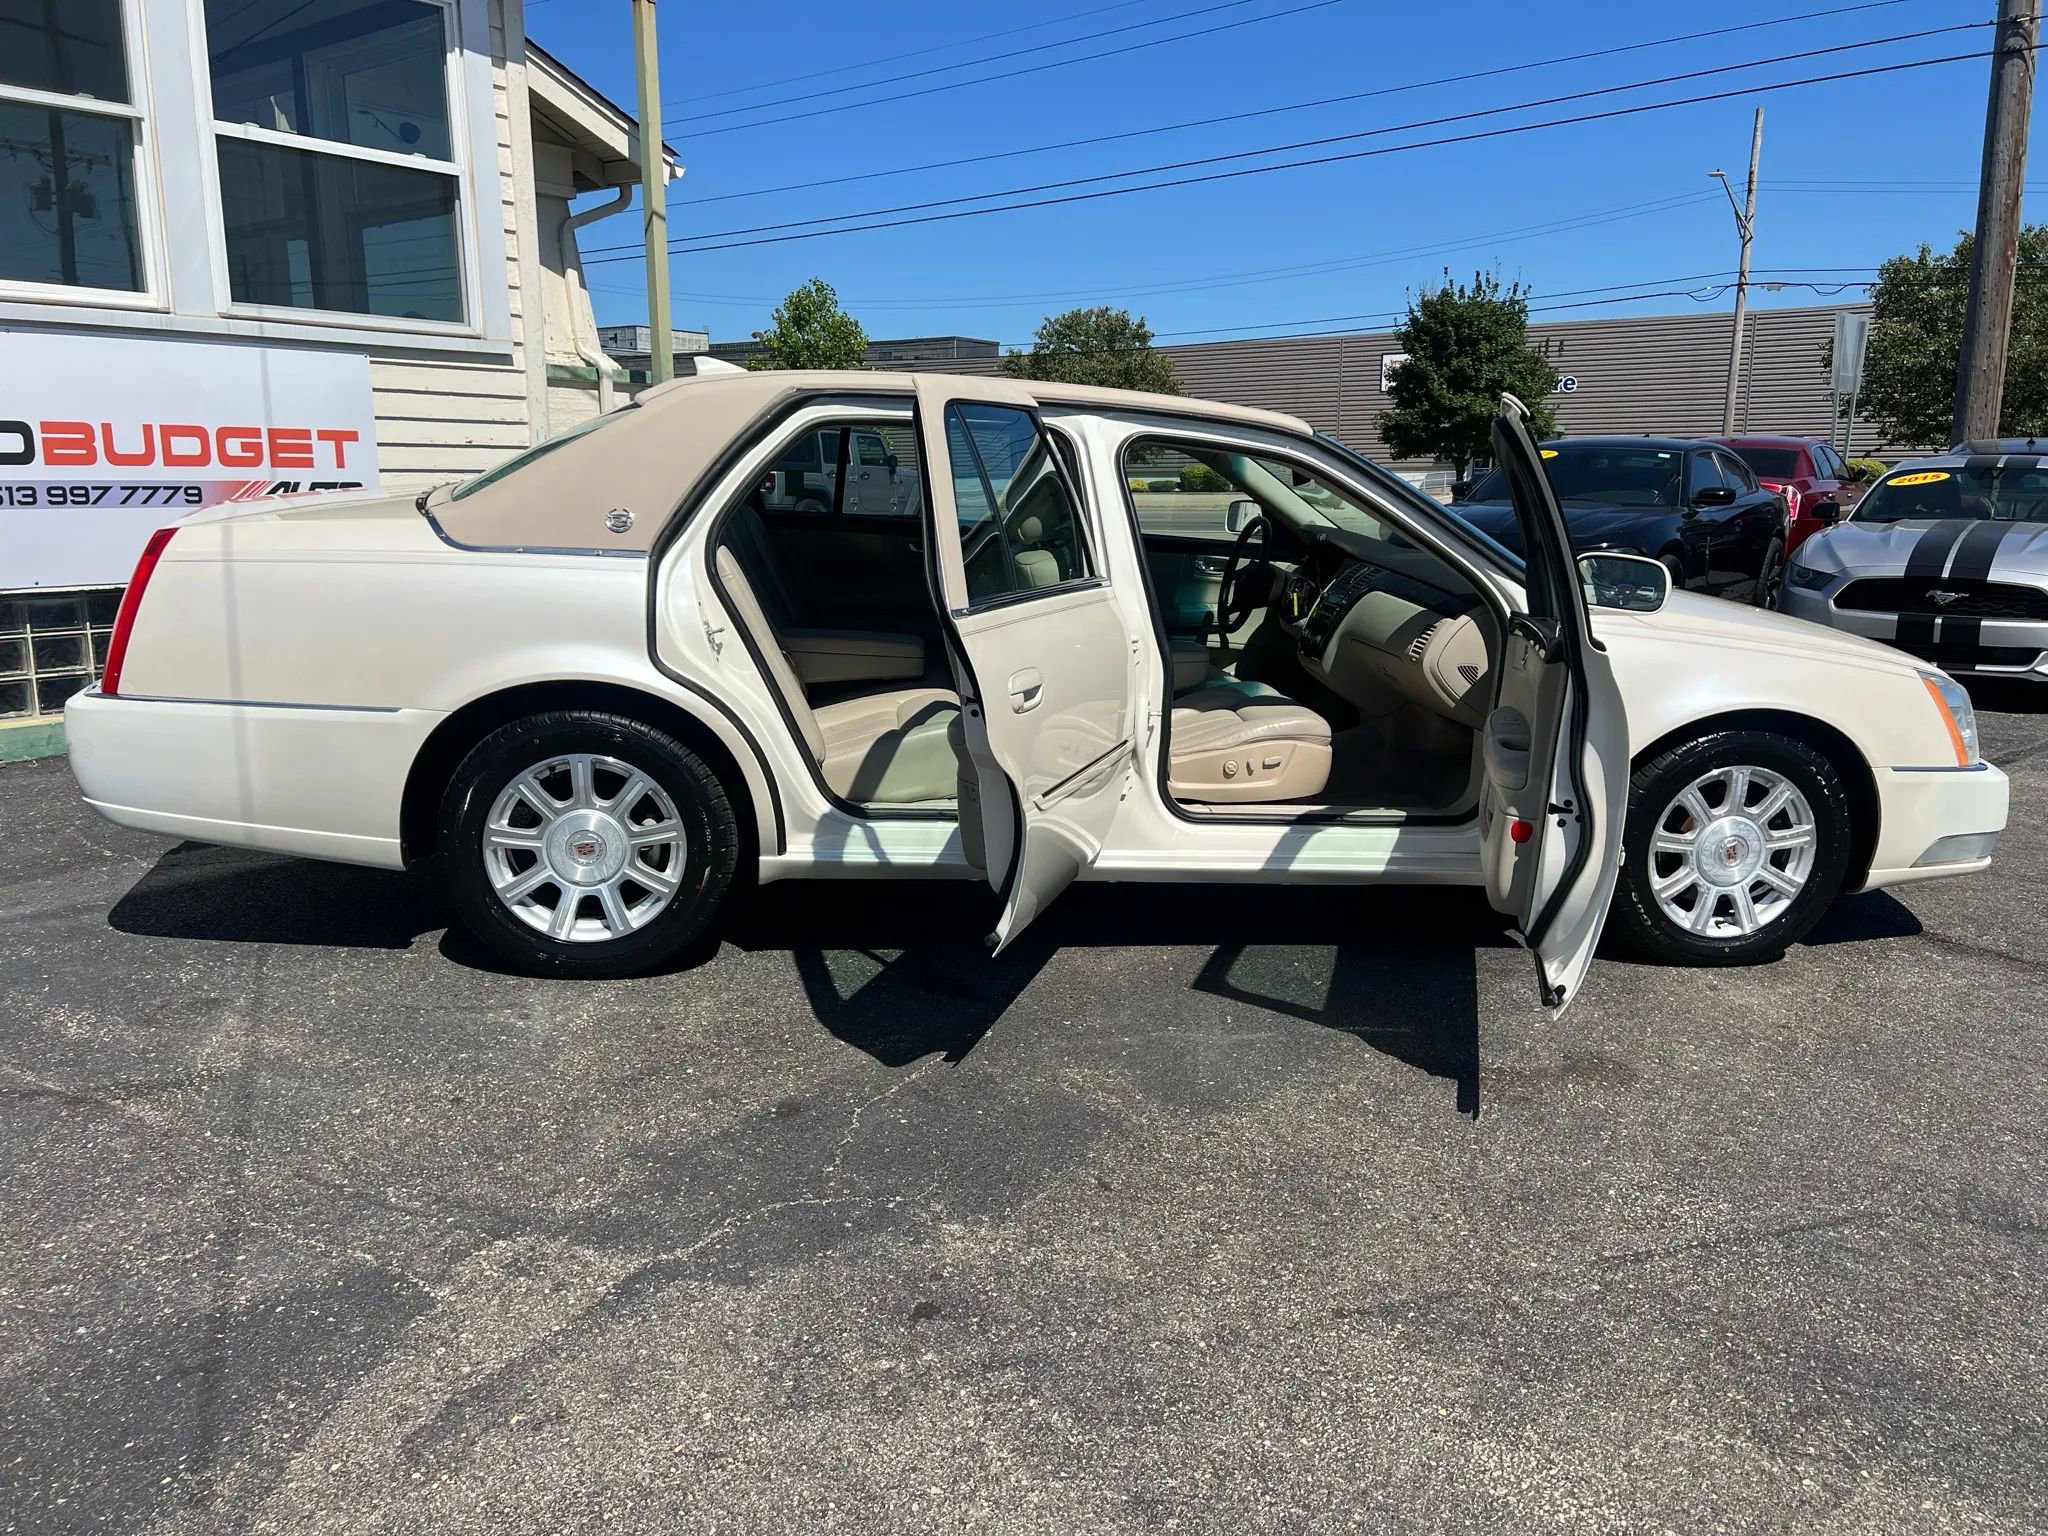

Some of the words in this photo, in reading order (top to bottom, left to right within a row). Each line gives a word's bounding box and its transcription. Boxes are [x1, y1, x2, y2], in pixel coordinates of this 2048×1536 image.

[1895, 474, 1942, 484] 2015
[0, 485, 37, 506] 13
[46, 485, 113, 505] 997
[119, 485, 203, 505] 7779
